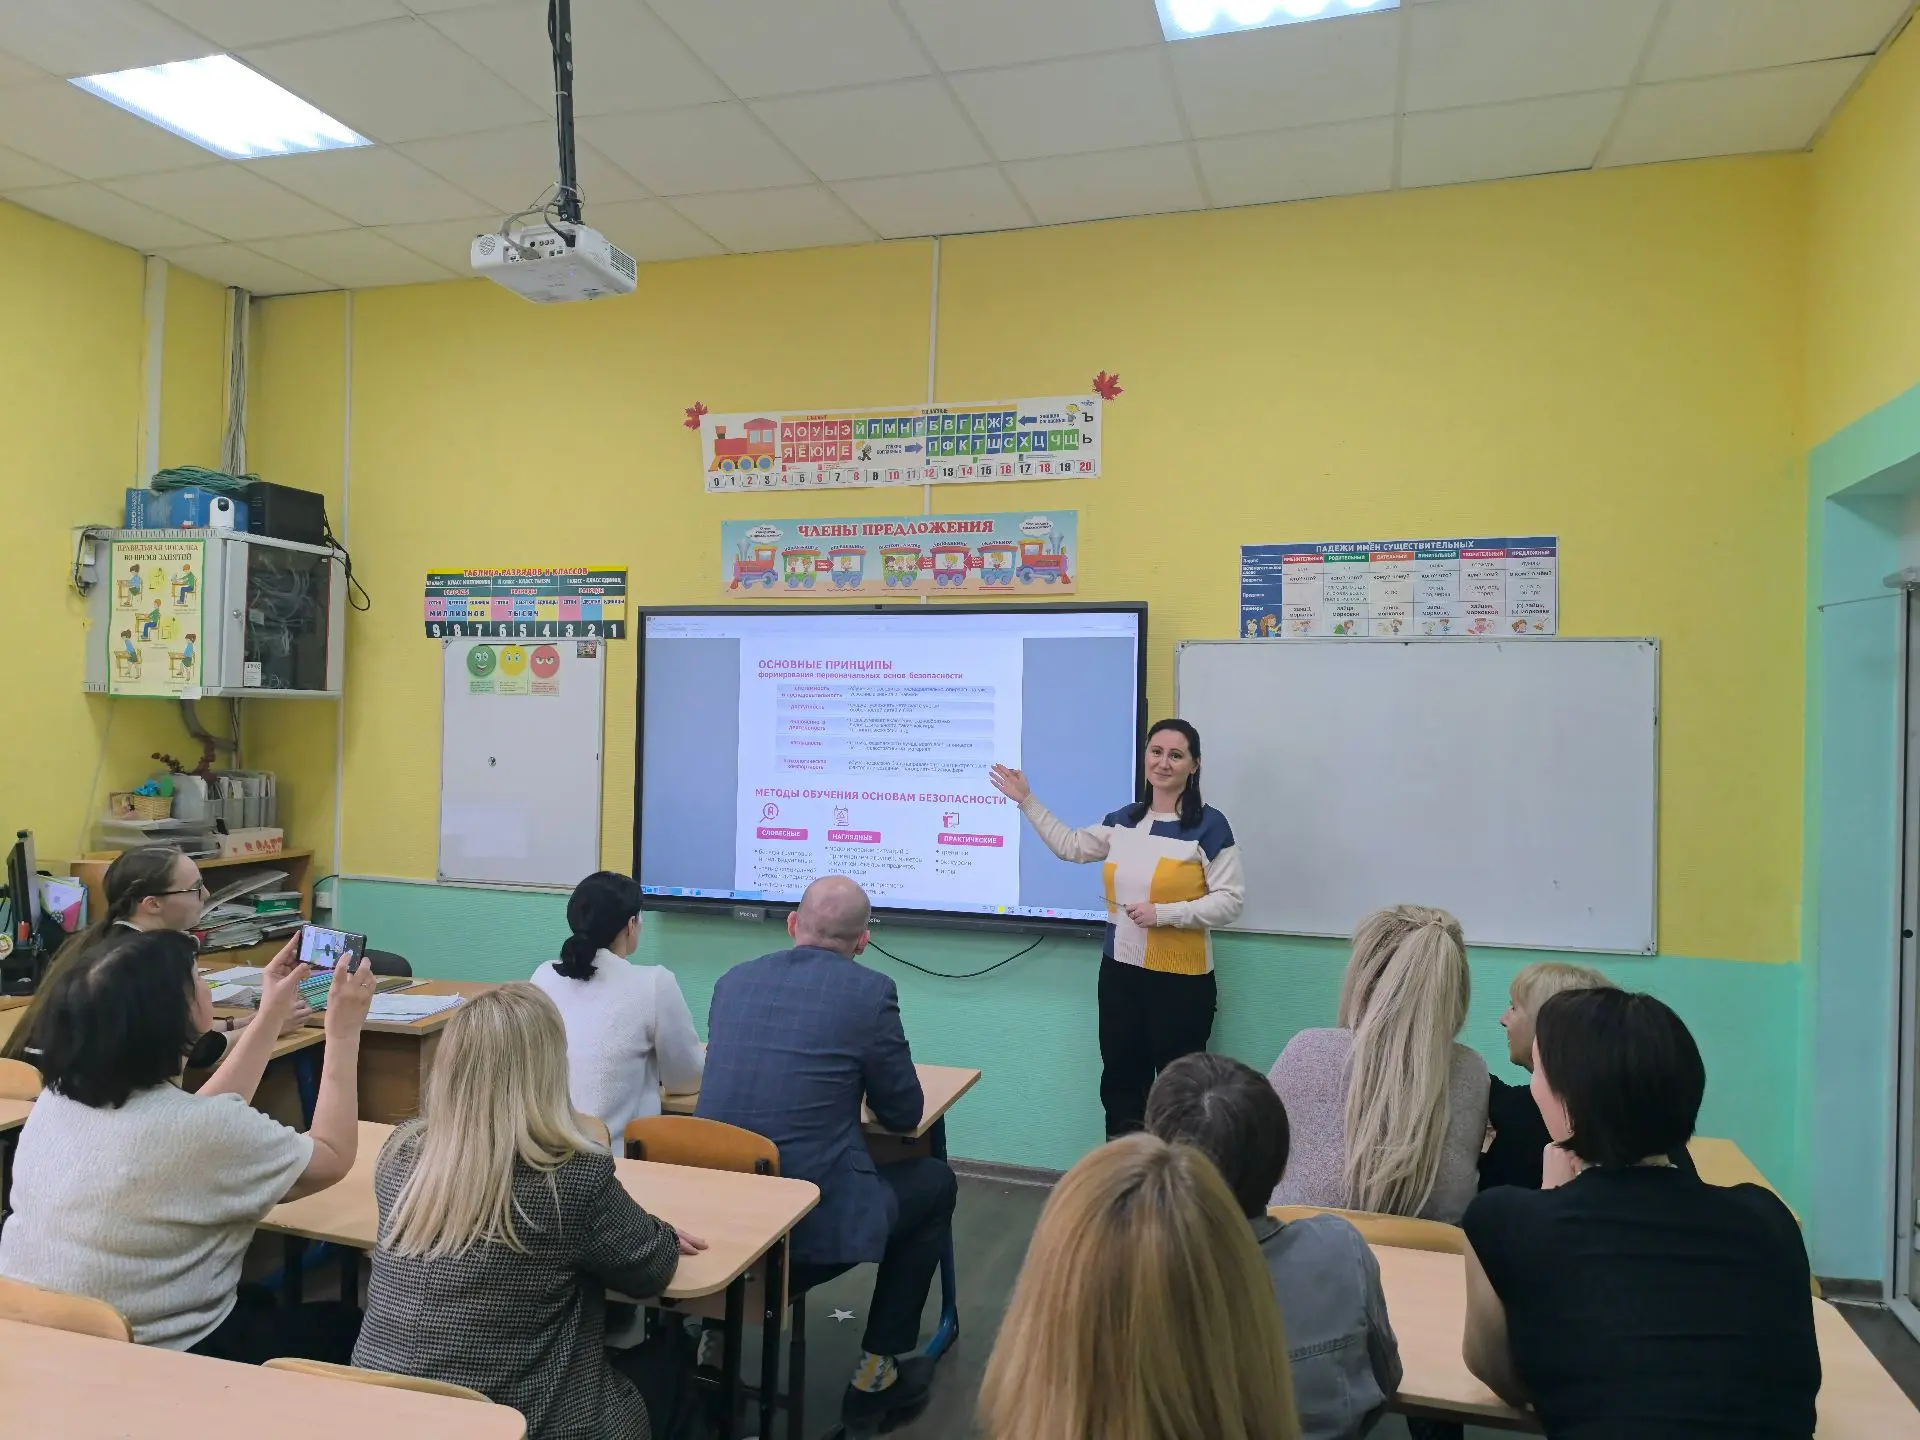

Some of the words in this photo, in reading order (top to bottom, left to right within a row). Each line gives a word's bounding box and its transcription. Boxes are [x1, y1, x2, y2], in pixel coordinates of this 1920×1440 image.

[783, 426, 792, 437] А
[796, 427, 807, 437] О
[812, 426, 821, 437] У
[824, 425, 837, 436] Ы
[841, 424, 850, 435] Э
[855, 420, 865, 434] Й
[870, 424, 881, 434] Л
[885, 423, 896, 433] М
[900, 422, 910, 433] Н
[915, 421, 925, 432] Р
[929, 420, 939, 431] Б
[944, 419, 954, 430] В
[959, 418, 967, 429] Г
[973, 417, 985, 430] Д
[987, 417, 1001, 428] Ж
[1005, 416, 1014, 427] З
[1081, 412, 1094, 422] Ъ
[783, 448, 793, 458] Я
[799, 444, 807, 457] Ё
[810, 446, 824, 457] Ю
[826, 446, 836, 456] И
[841, 445, 850, 455] Е
[928, 440, 938, 451] П
[942, 439, 954, 451] Ф
[958, 439, 967, 450] К
[975, 439, 985, 449] Т
[987, 438, 1001, 449] Ш
[1004, 437, 1014, 448] С
[1019, 436, 1029, 447] Х
[1034, 435, 1046, 448] Ц
[1051, 434, 1061, 445] Ч
[1064, 434, 1080, 446] Щ
[1082, 434, 1093, 444] Ь
[714, 477, 720, 487] 0
[730, 476, 735, 486] 1
[747, 475, 753, 485] 2
[764, 475, 771, 485] 3
[781, 474, 788, 484] 4
[799, 473, 805, 483] 5
[816, 473, 823, 482] 6
[835, 472, 842, 482] 7
[853, 472, 860, 481] 8
[873, 471, 879, 481] 9
[888, 470, 900, 480] 10
[906, 470, 917, 480] 11
[923, 468, 935, 478] 12
[942, 467, 954, 477] 13
[961, 466, 973, 476] 14
[980, 465, 992, 475] 15
[1000, 464, 1012, 474] 16
[1019, 463, 1031, 473] 17
[1039, 463, 1051, 473] 18
[1059, 462, 1071, 472] 19
[1079, 461, 1092, 471] 20
[798, 524, 857, 537] ЧЛЕНЫ
[862, 520, 994, 536] ПРЕДЛОЖЕНИЯ
[1316, 544, 1355, 553] ПАДЕЖИ
[1356, 541, 1382, 551] ИМЁН
[1383, 540, 1474, 551] СУЩЕСТВИТЕЛЬНЫХ
[463, 568, 499, 577] ТАБЛИЦА
[500, 568, 542, 577] РАЗРЯДОВ
[552, 567, 588, 577] КЛАССОВ
[432, 623, 440, 637] 9
[453, 623, 462, 637] 8
[475, 623, 482, 637] 7
[499, 623, 507, 637] 6
[519, 623, 527, 637] 5
[542, 623, 551, 637] 4
[565, 623, 574, 637] 3
[587, 623, 596, 637] 2
[610, 623, 617, 637] 1
[758, 659, 822, 670] ОСНОВНЫЕ
[825, 660, 893, 671] ПРИНЦИПЫ
[758, 671, 814, 680] формирования
[909, 671, 963, 680] безопасности
[755, 788, 800, 799] МЕТОДЫ
[802, 789, 859, 801] ОБУЧЕНИЯ
[861, 791, 916, 802] ОСНОВАМ
[919, 793, 1007, 805] БЕЗОПАСНОСТИ
[761, 829, 801, 837] СЛОВЕСНЫЕ
[832, 833, 873, 841] НАГЛЯДНЫЕ
[943, 836, 997, 845] ПРАКТИЧЕСКИЕ
